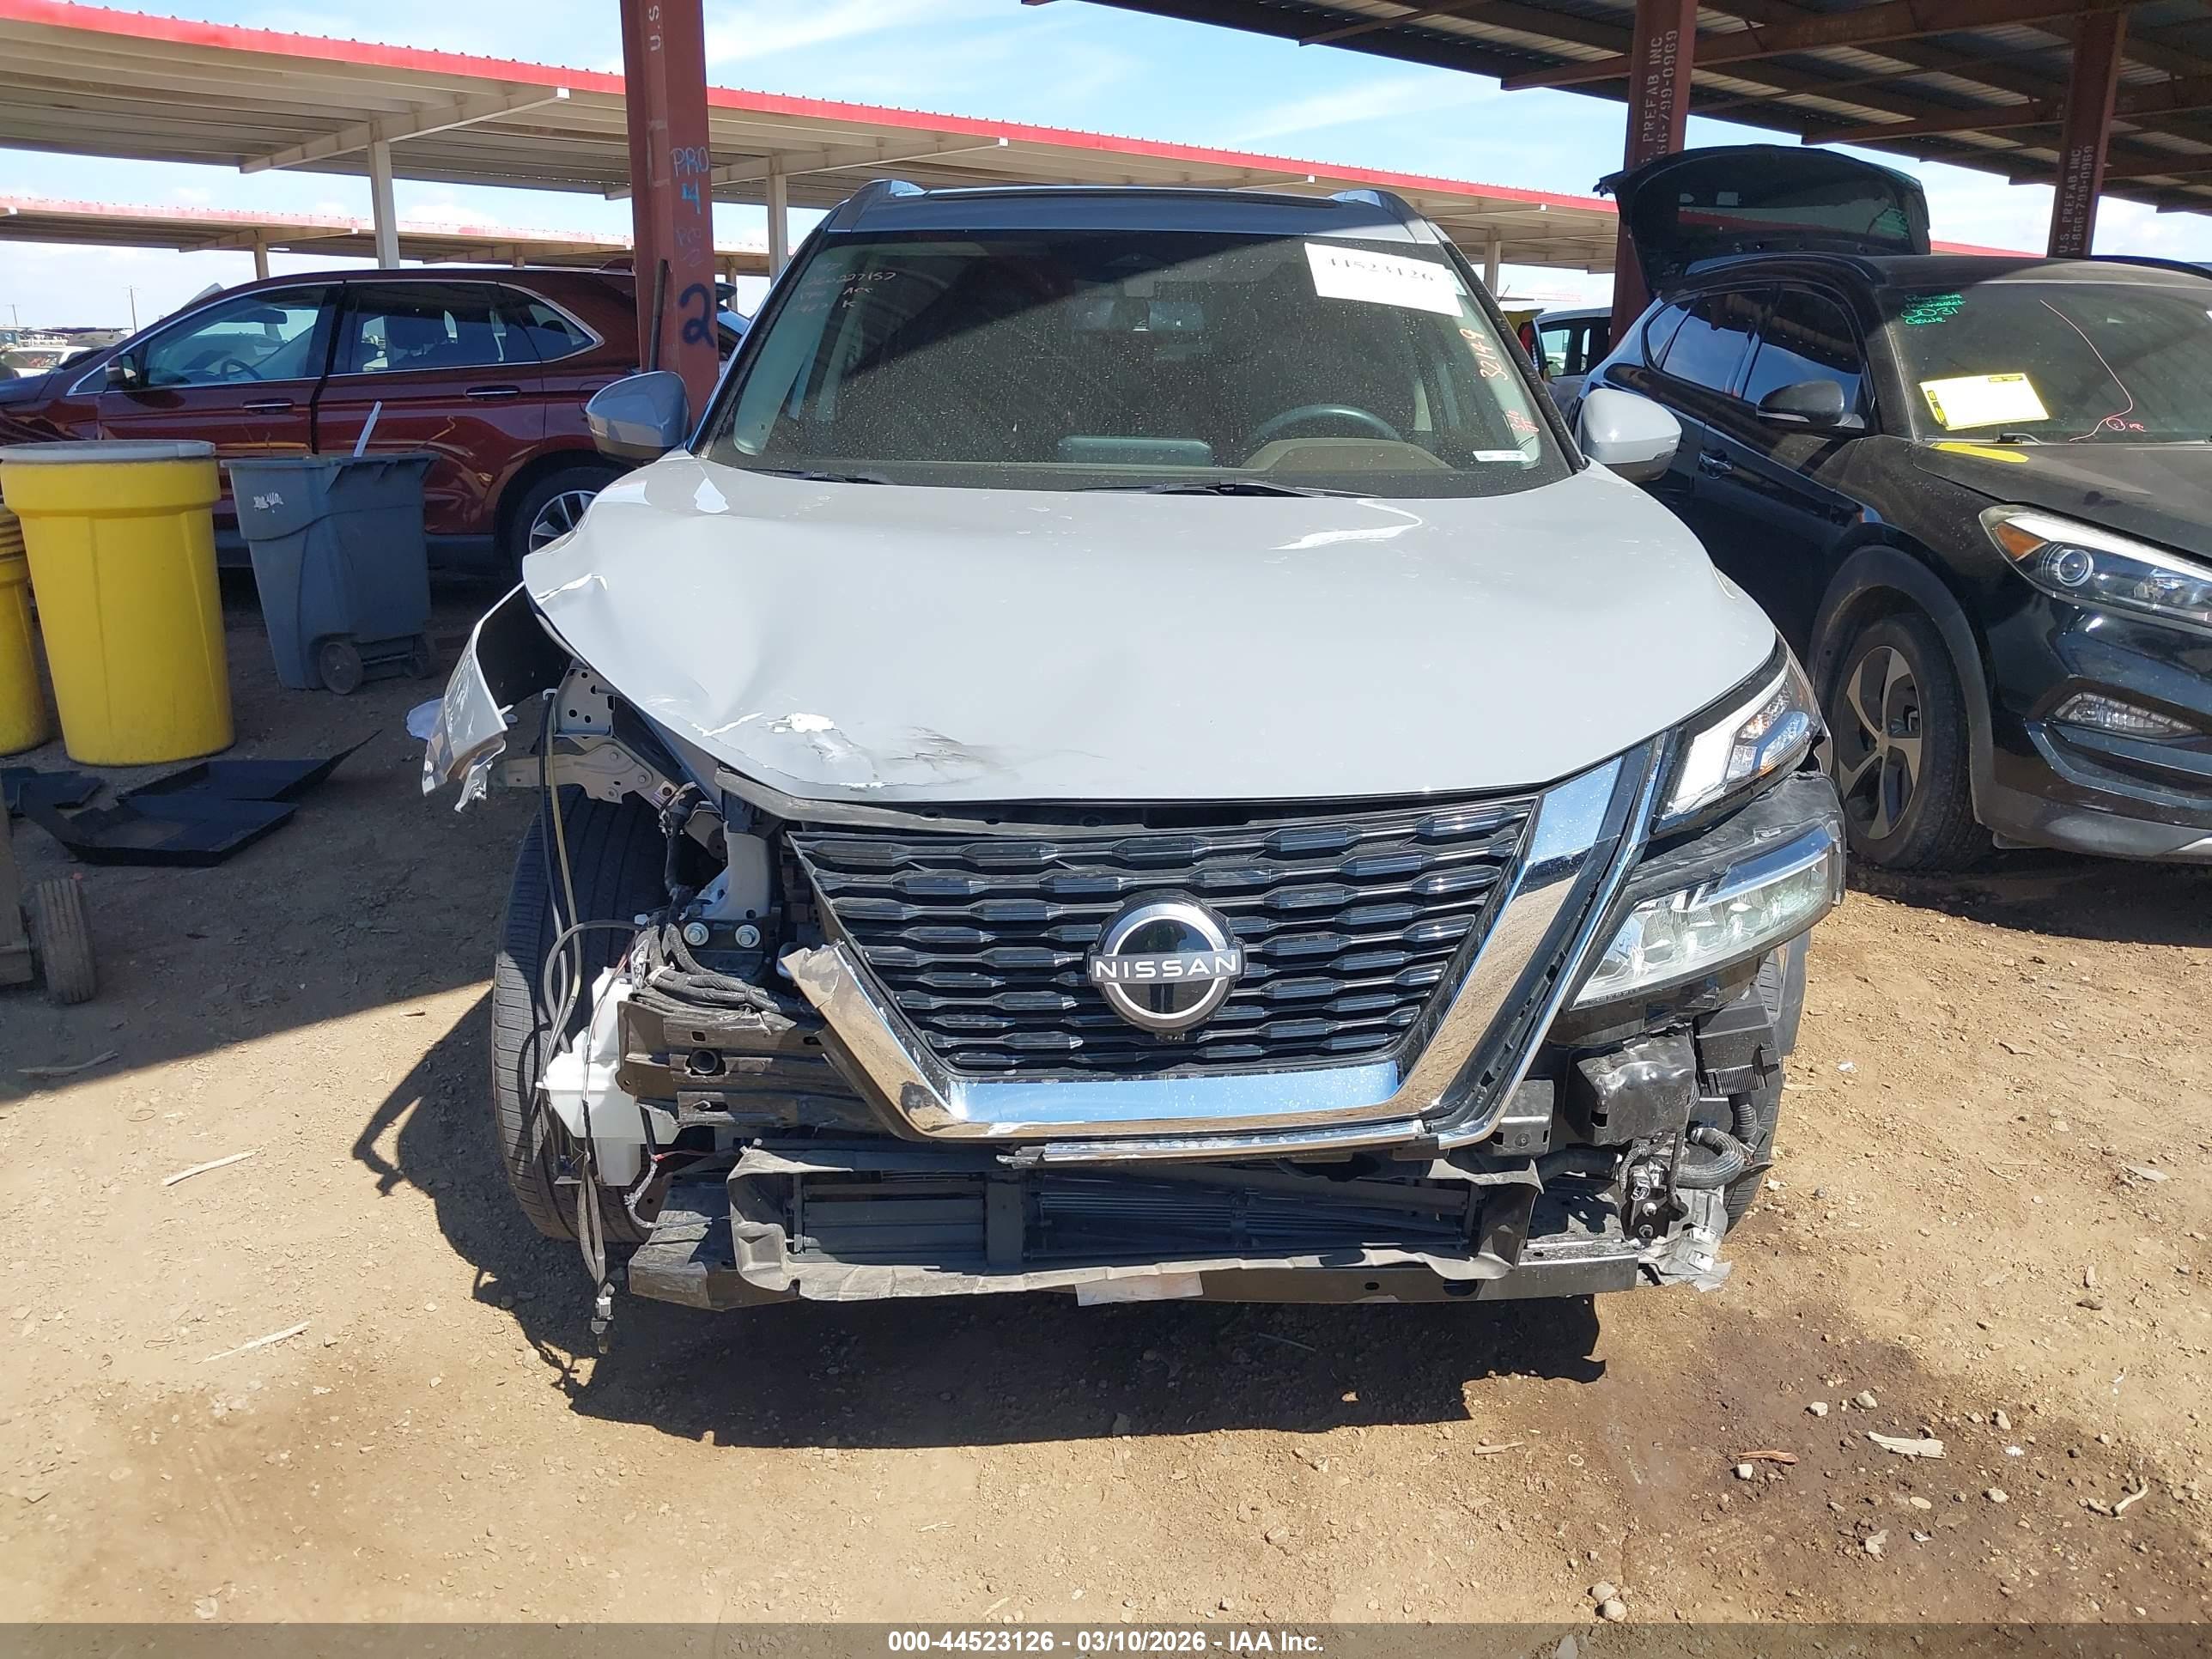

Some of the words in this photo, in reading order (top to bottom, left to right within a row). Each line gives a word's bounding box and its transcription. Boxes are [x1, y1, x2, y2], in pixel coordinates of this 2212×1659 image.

[1642, 74, 1660, 143] PREFAB
[670, 147, 708, 178] PRO
[681, 179, 702, 215] 4
[2062, 174, 2078, 223] PREFAB
[678, 283, 714, 348] 2
[1096, 955, 1237, 978] NISSAN
